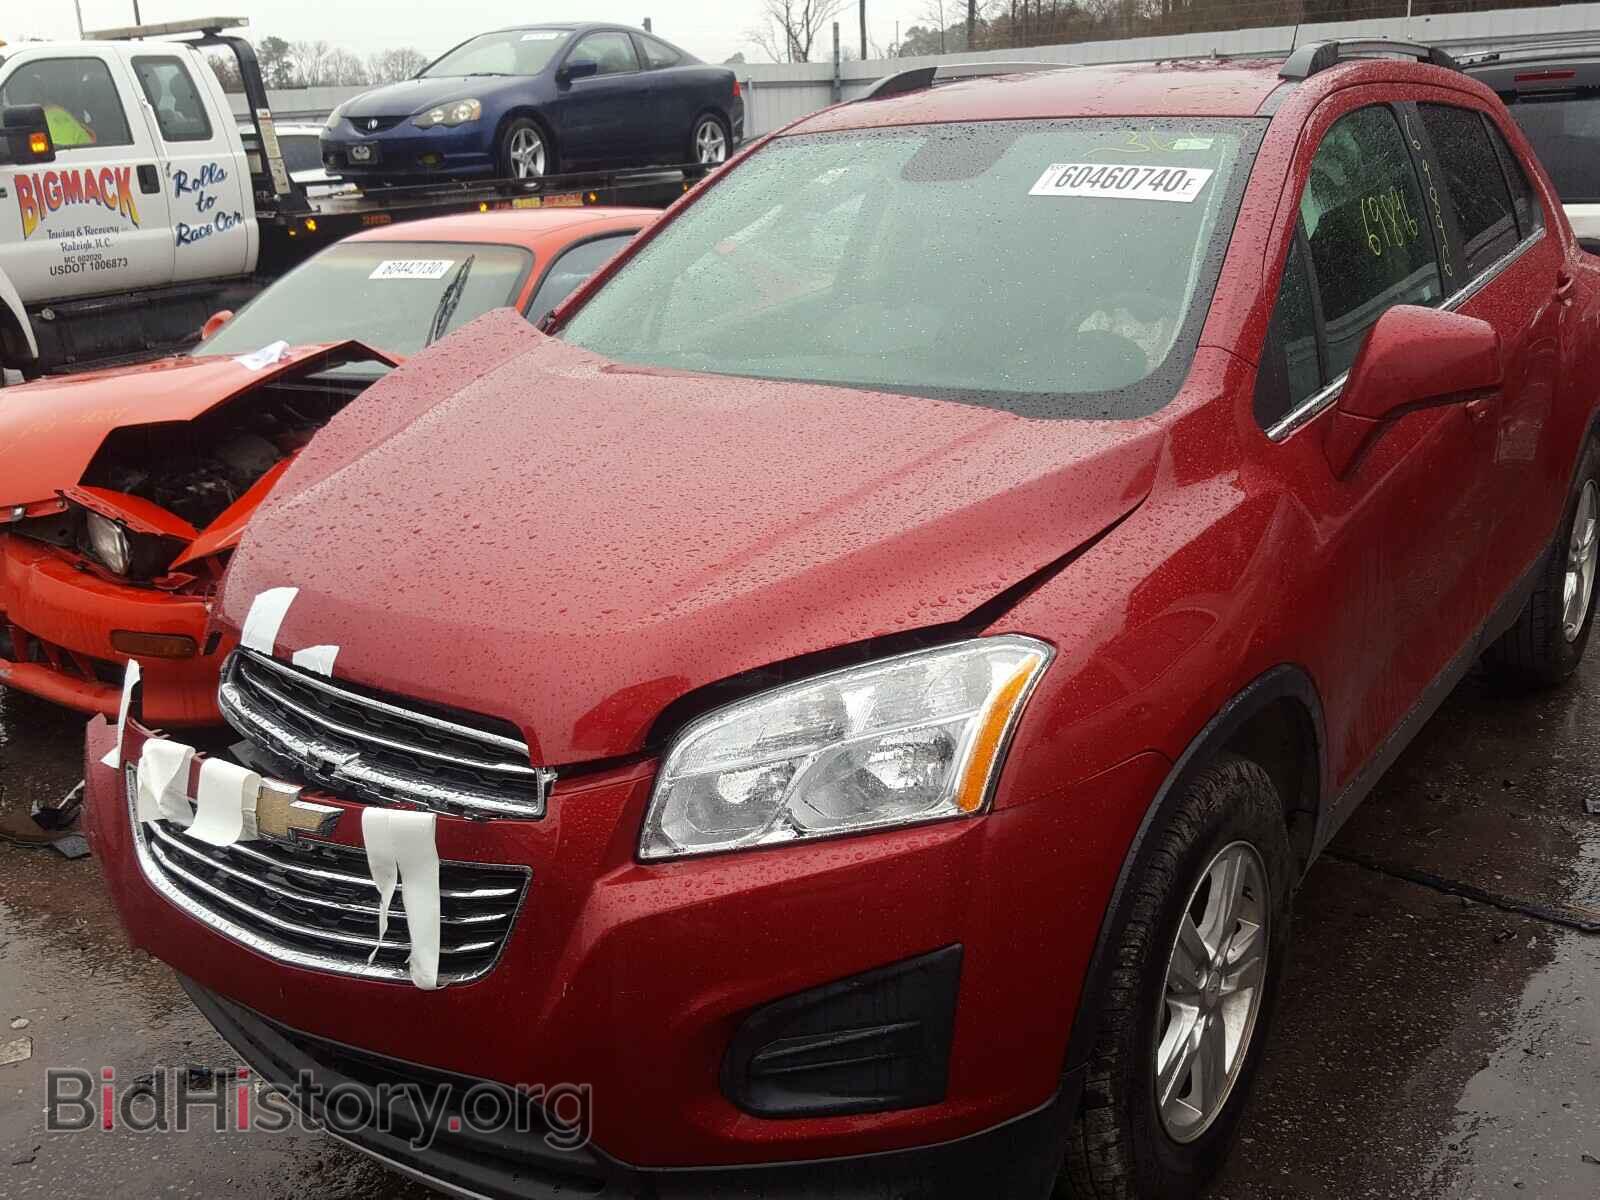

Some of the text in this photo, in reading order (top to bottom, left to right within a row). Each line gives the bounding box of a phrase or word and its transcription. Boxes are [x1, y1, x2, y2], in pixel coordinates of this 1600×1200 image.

[173, 163, 228, 198] Rolls
[1054, 166, 1188, 193] 60460740
[14, 167, 140, 240] BIGMACK
[195, 191, 217, 213] to
[47, 229, 75, 240] Towing
[76, 226, 83, 237] &
[83, 225, 119, 236] Recovery
[176, 210, 243, 247] Race Car
[50, 257, 128, 276] USDOT 1006873
[64, 256, 76, 264] MC
